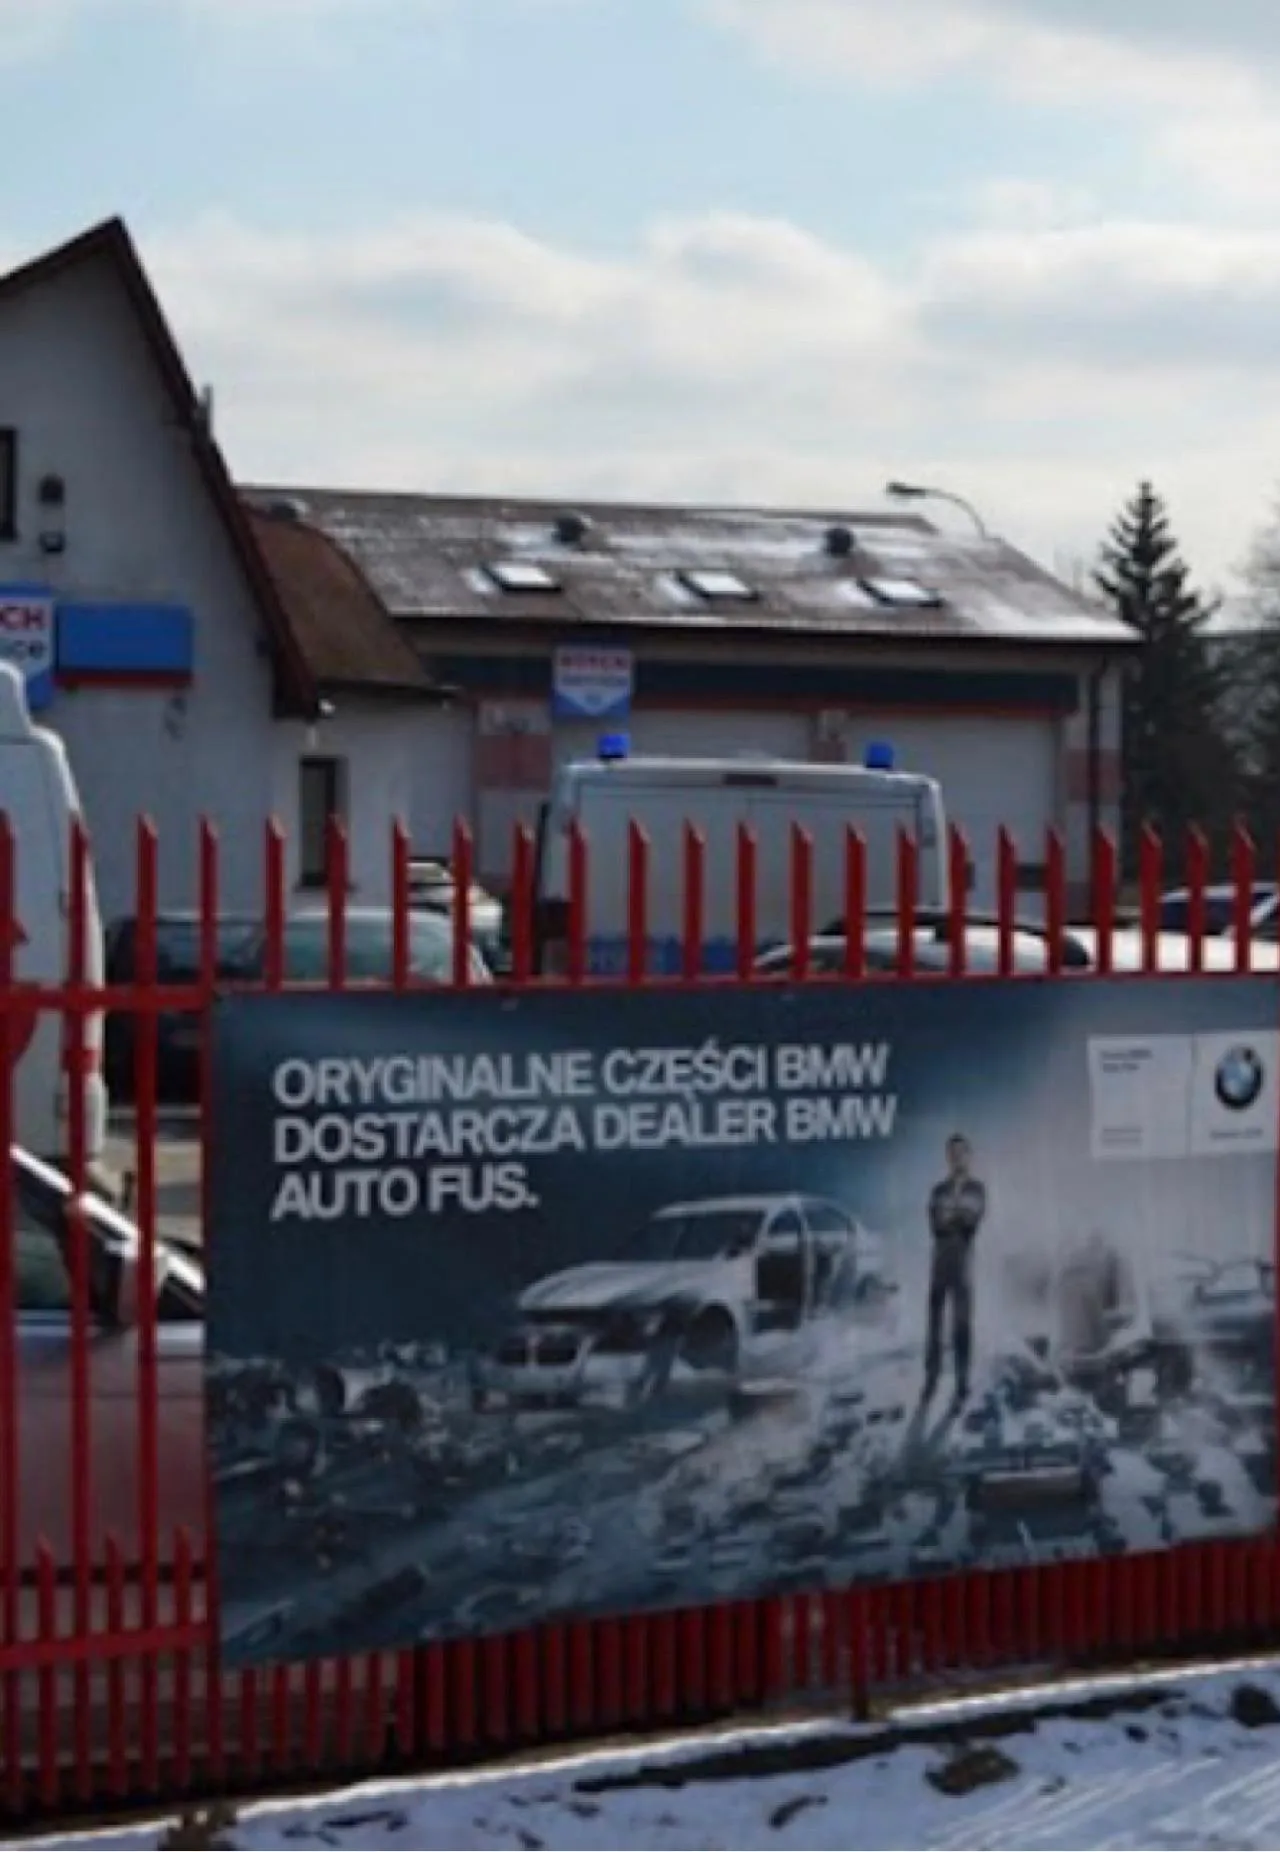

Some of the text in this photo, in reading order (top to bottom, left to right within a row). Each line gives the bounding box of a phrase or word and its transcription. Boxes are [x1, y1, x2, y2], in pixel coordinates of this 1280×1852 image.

[272, 1036, 891, 1108] ORYGINALNE CZĘŚCI BMW
[271, 1094, 897, 1165] DOSTARCZA DEALER BMW
[270, 1162, 540, 1223] AUTO FUS.
